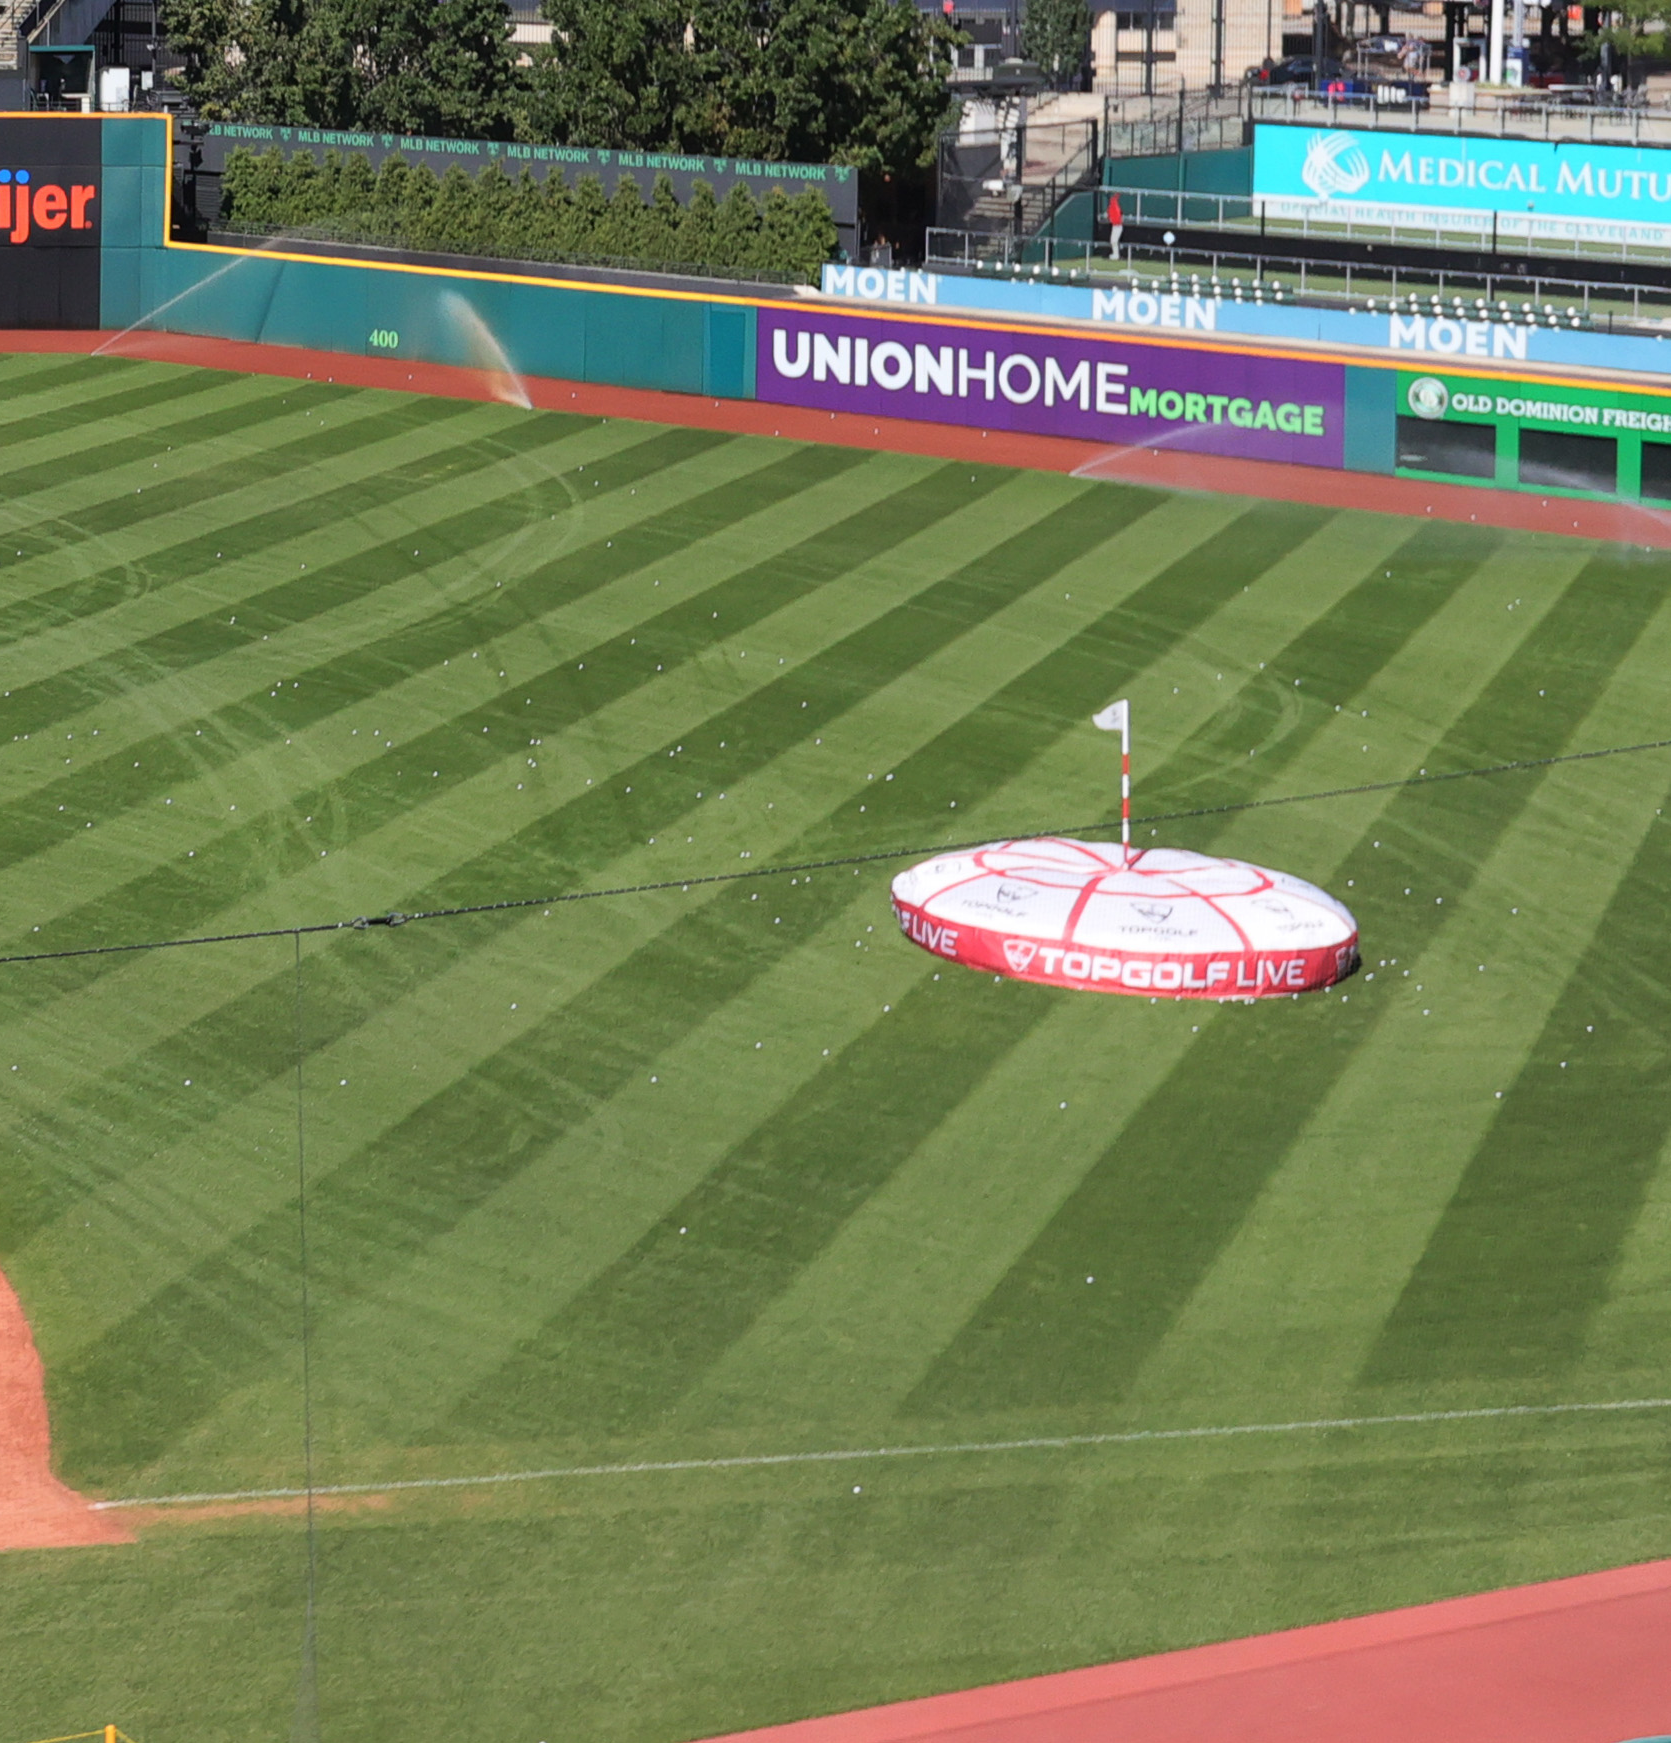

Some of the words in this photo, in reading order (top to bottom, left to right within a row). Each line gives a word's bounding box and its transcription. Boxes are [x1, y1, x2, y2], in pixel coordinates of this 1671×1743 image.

[224, 125, 273, 141] NETWORK
[297, 130, 320, 143] MLB
[323, 132, 375, 147] NETWORK
[400, 137, 423, 151] MLB
[426, 139, 480, 155] NETWORK
[507, 144, 530, 158] MLB
[533, 146, 590, 163] NETWORK
[618, 153, 643, 168] MLB
[646, 154, 705, 172] NETWORK
[734, 161, 761, 176] MLB
[764, 163, 827, 181] NETWORK
[1377, 149, 1546, 193] MEDICAL
[1499, 217, 1523, 230] OF
[824, 264, 938, 305] MOEN
[1092, 287, 1216, 331] MOEN
[369, 328, 399, 349] 400
[1388, 313, 1528, 360] MOEN
[1129, 386, 1325, 436] MORTGAGE
[1452, 392, 1493, 413] OLD
[1496, 398, 1599, 425] DOMINION
[911, 920, 959, 956] LIVE
[1039, 946, 1230, 989] TOPGOLF
[1236, 958, 1306, 986] LIVE
